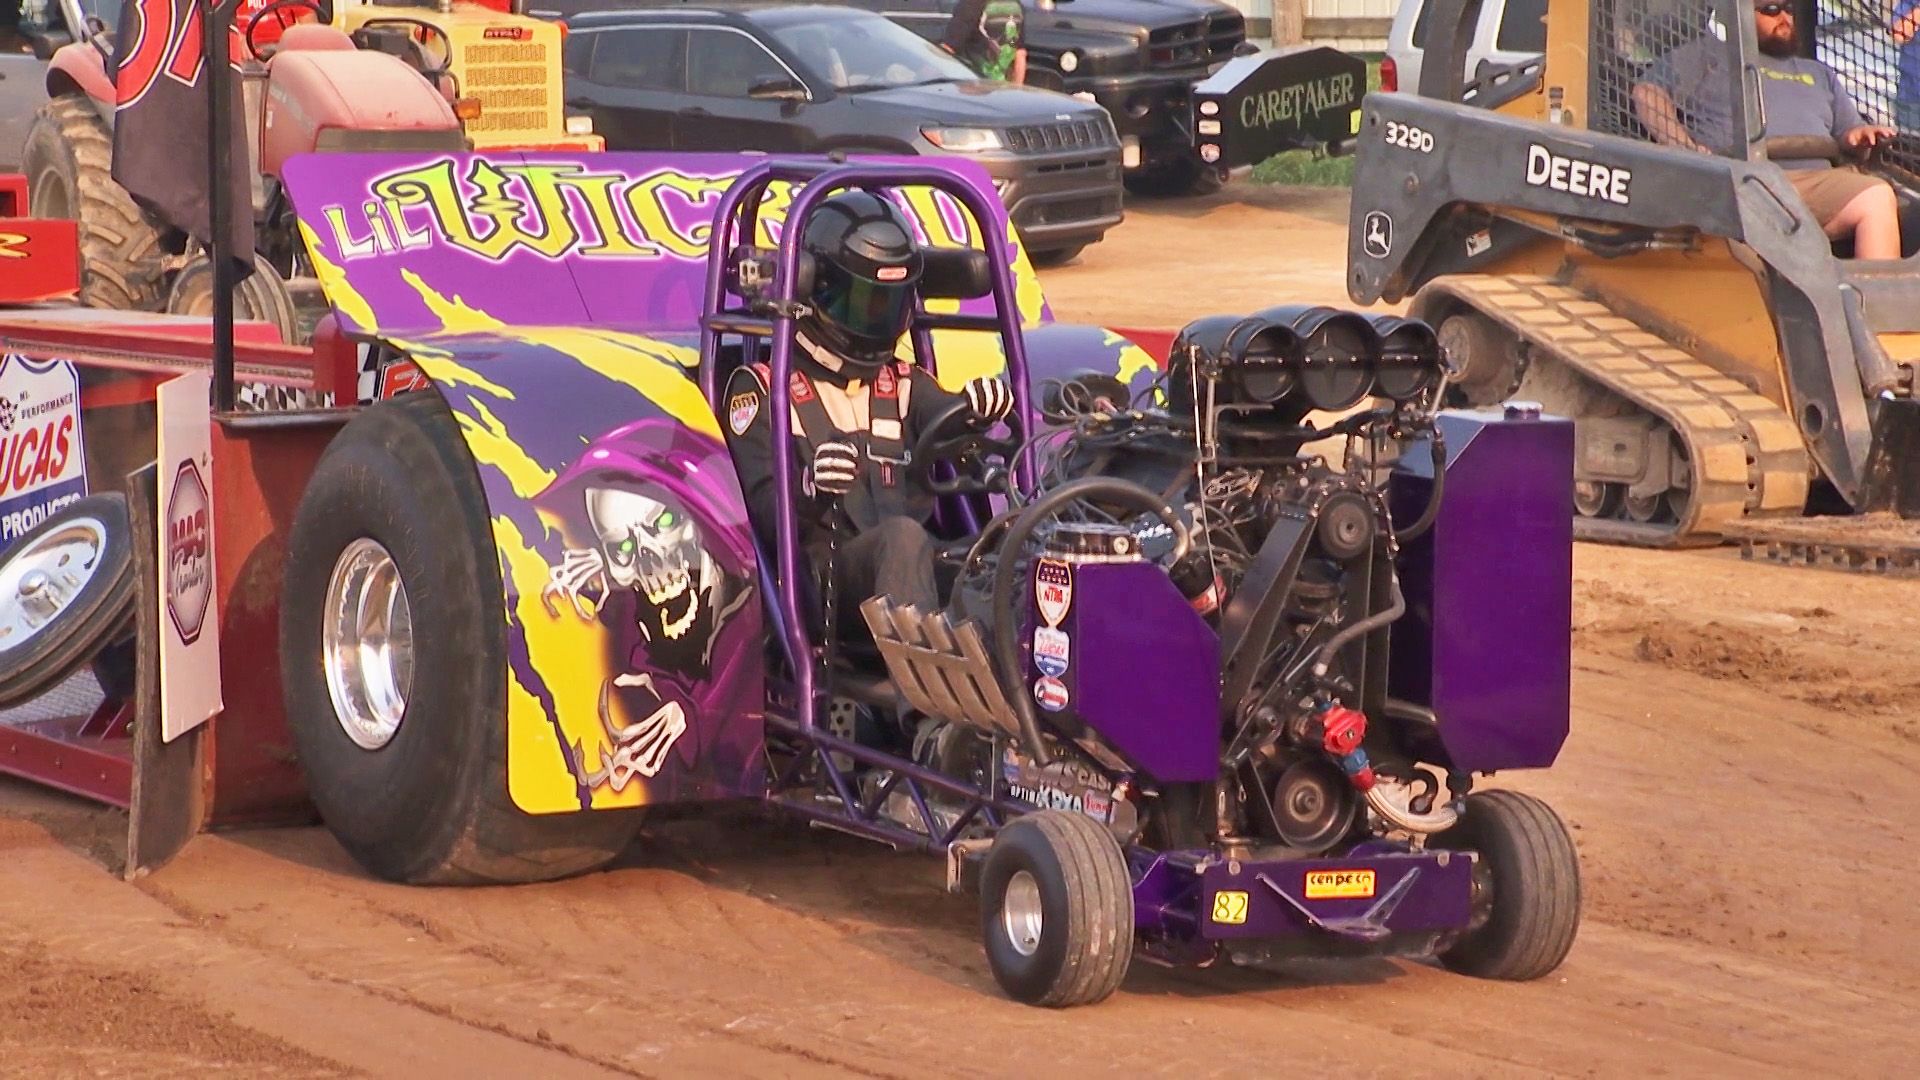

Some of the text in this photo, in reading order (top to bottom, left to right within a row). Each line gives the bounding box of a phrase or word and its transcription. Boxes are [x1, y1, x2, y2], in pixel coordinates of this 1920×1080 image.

[1240, 72, 1355, 130] CARETAKER
[1385, 121, 1434, 154] 329D
[1526, 143, 1632, 205] DEERE
[371, 158, 986, 261] WICKD
[20, 392, 73, 420] PERFORMANCE
[1214, 893, 1247, 920] 82
